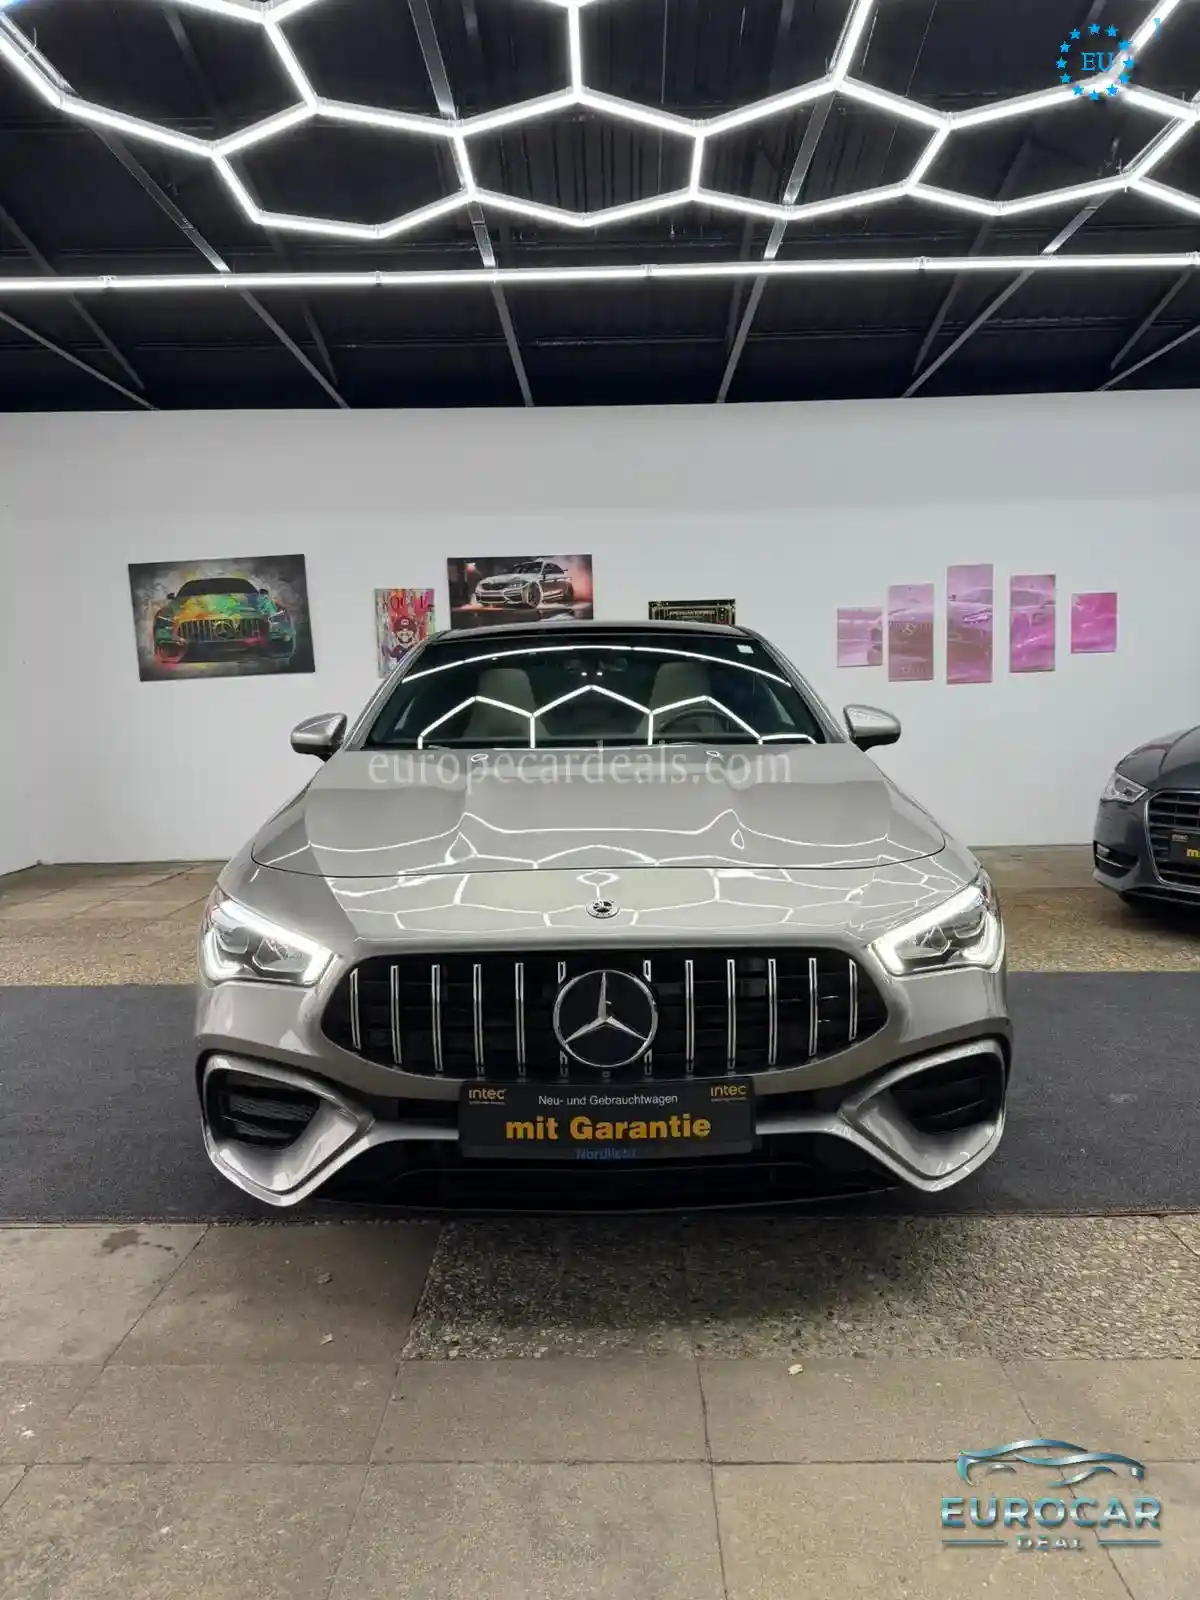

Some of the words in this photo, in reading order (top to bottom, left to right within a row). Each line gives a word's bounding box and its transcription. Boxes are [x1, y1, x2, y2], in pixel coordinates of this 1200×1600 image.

[469, 1088, 505, 1100] intec
[711, 1085, 747, 1098] intec
[539, 1095, 564, 1105] Neu-
[567, 1095, 587, 1105] und
[590, 1094, 678, 1108] Gebrauchtwagen
[505, 1115, 558, 1140] mit
[570, 1113, 712, 1140] Garantie
